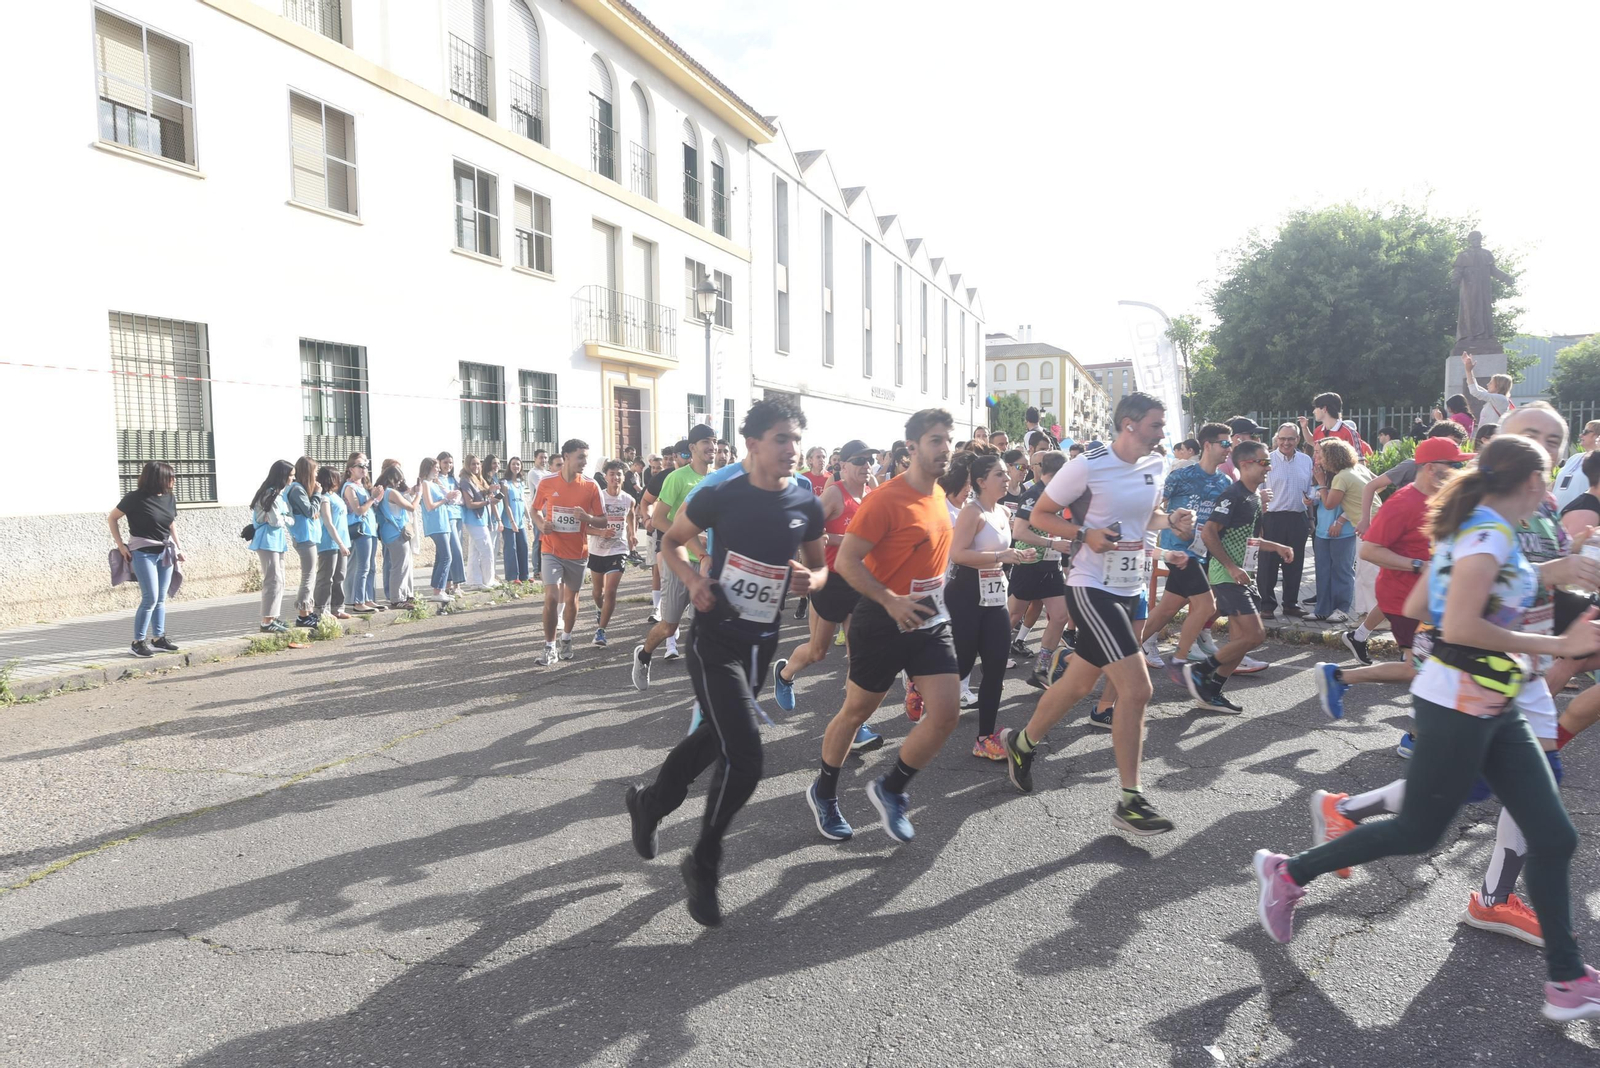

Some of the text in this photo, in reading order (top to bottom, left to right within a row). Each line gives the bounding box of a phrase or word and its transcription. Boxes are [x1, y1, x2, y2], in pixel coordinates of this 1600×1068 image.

[556, 516, 575, 525] 498
[1120, 556, 1137, 571] 31
[730, 578, 771, 603] 496
